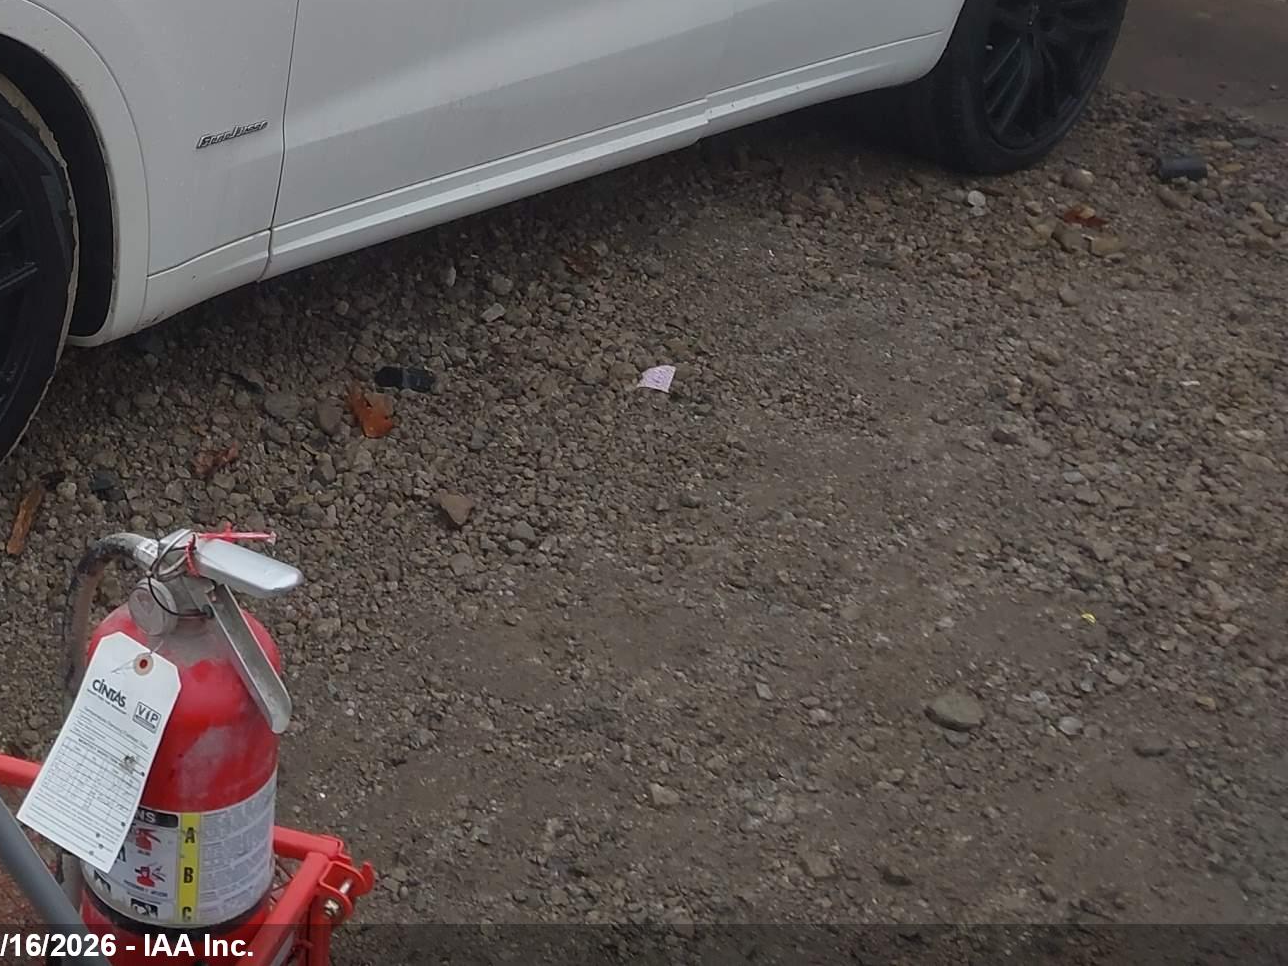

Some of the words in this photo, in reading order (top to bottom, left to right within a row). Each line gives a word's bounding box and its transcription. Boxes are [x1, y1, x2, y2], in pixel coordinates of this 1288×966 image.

[92, 679, 127, 708] CINTAS
[138, 705, 159, 722] VIP
[184, 827, 196, 844] A
[183, 867, 194, 884] B
[182, 906, 192, 922] C
